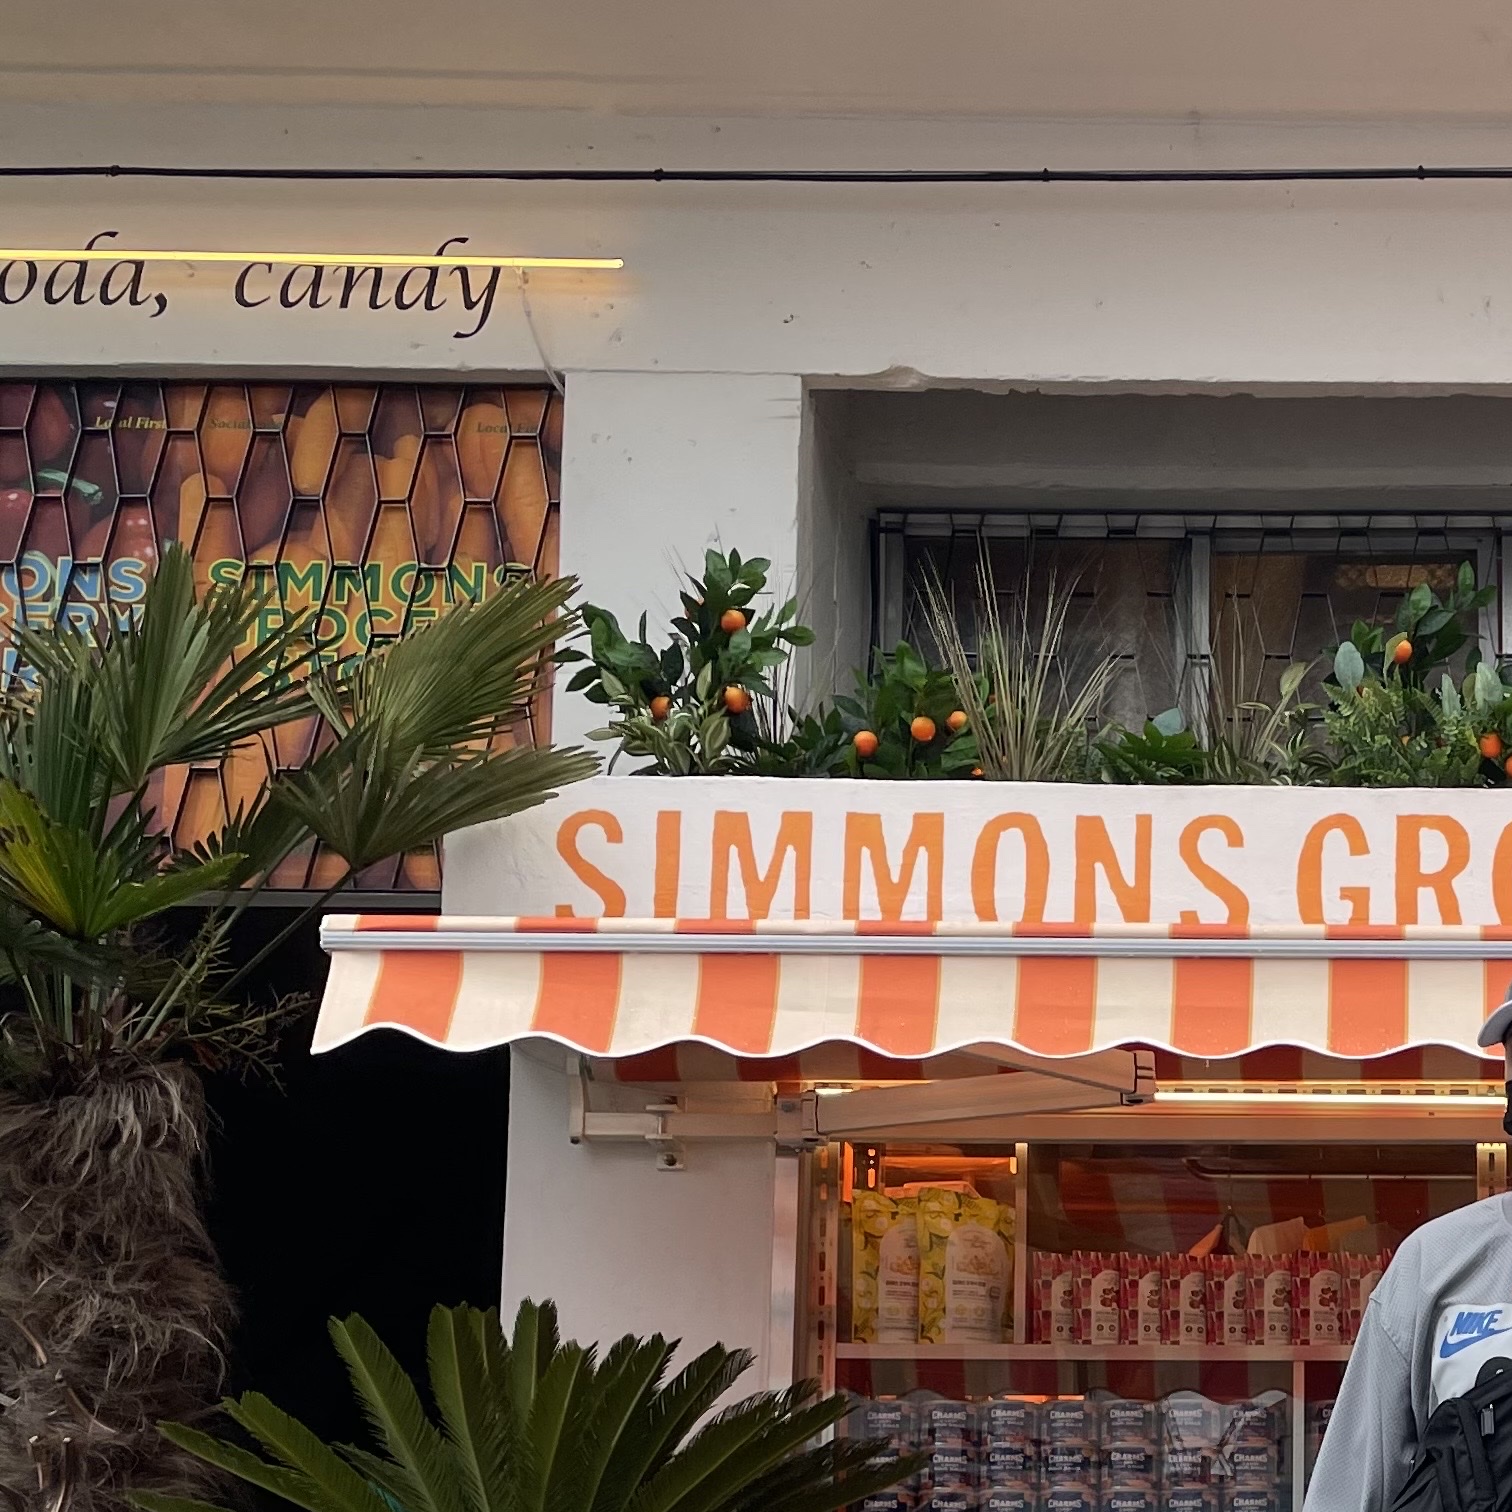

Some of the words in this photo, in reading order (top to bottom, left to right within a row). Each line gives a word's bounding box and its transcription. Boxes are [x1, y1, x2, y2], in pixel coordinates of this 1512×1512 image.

[235, 237, 502, 338] candy
[555, 809, 1250, 924] SIMMONS
[1450, 1310, 1503, 1336] NIKE
